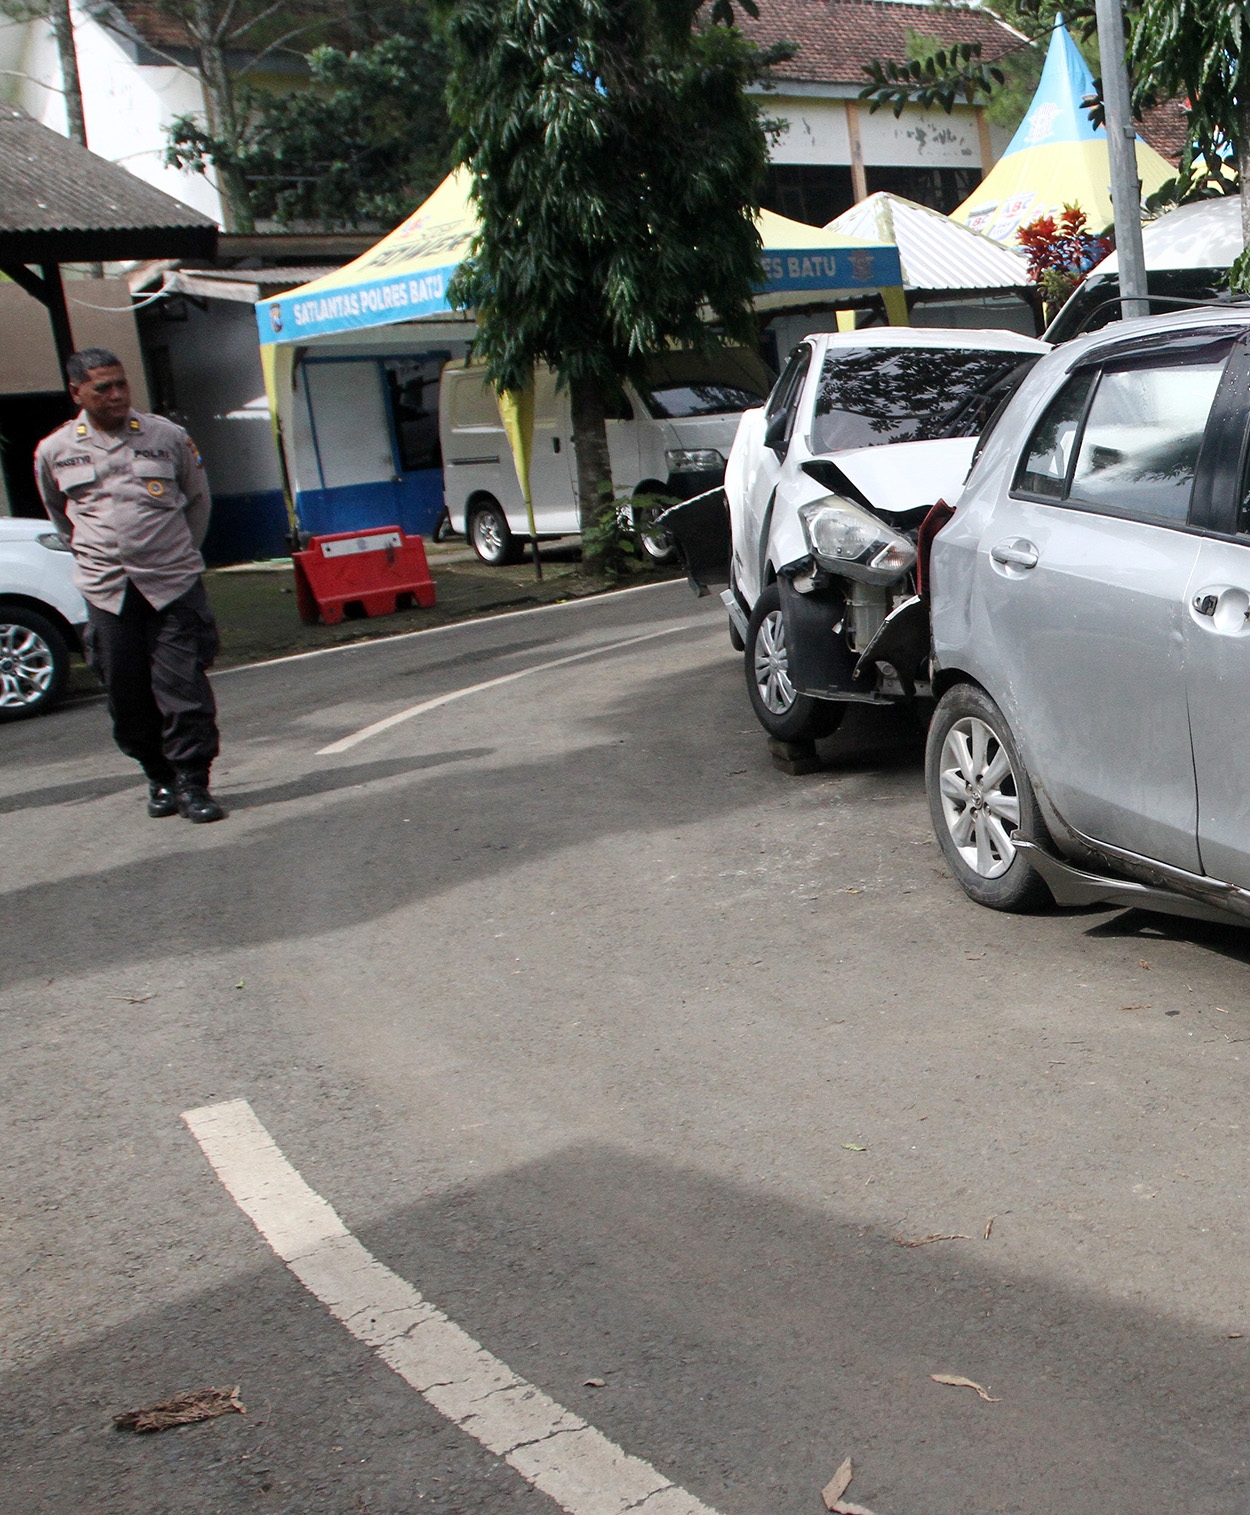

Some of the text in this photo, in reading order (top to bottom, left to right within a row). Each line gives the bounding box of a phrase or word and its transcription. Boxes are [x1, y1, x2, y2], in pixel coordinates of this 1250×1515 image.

[787, 256, 836, 278] BATU
[293, 274, 443, 325] SATLANTAS POLRES BATU
[134, 449, 169, 459] POLRI
